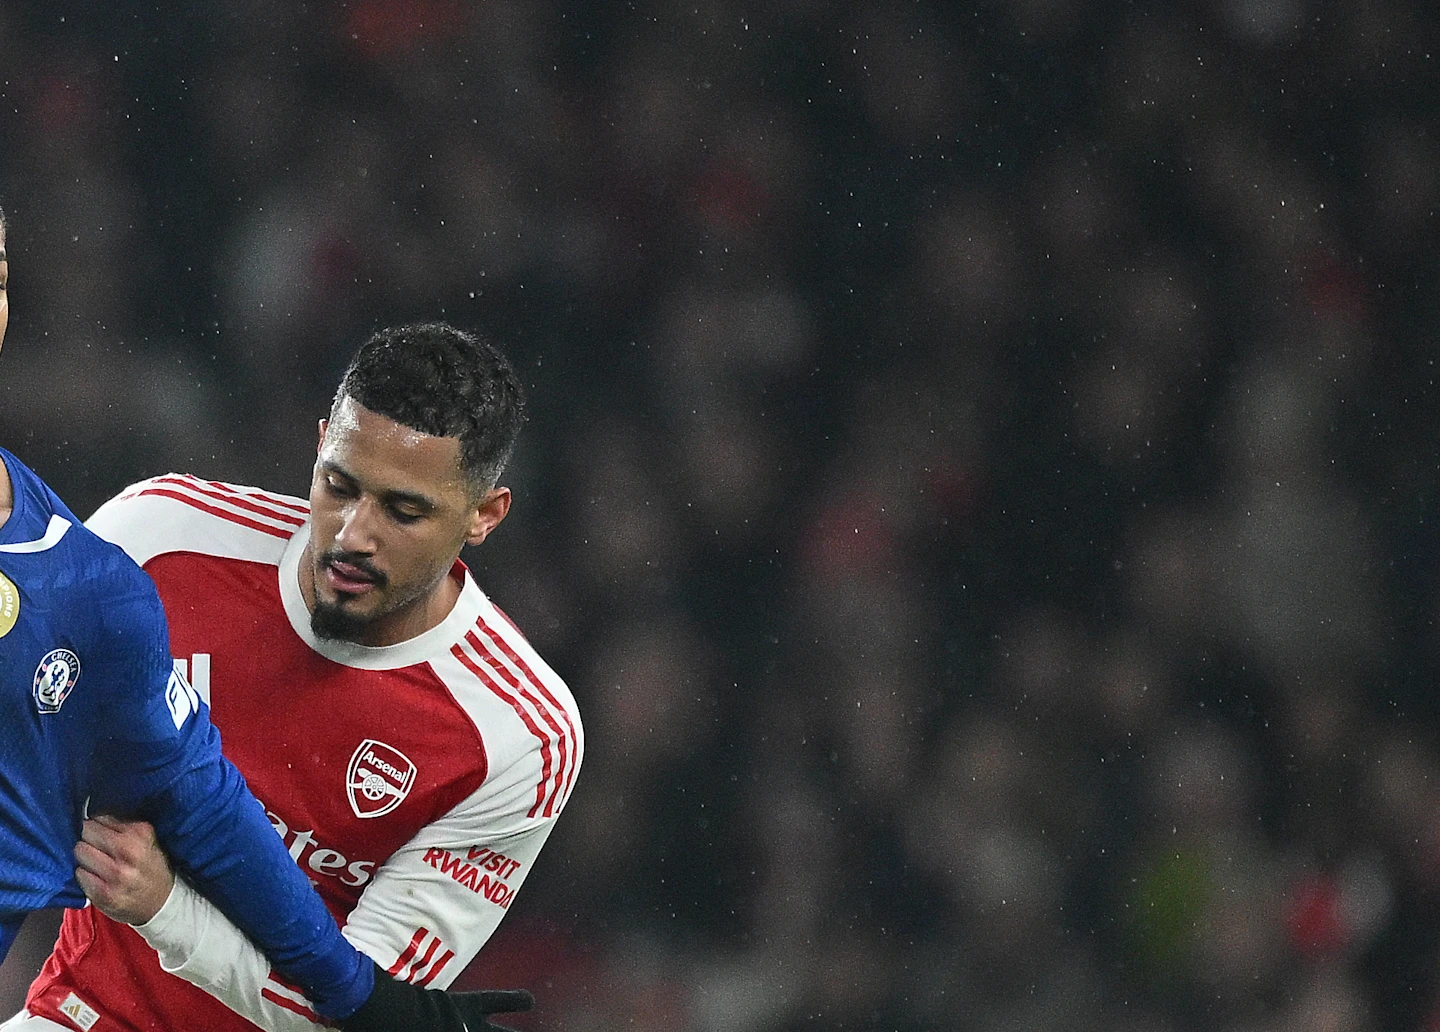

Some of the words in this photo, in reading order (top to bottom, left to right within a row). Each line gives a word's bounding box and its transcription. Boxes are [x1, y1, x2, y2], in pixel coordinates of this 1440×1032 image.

[51, 651, 77, 673] CHELSEA
[362, 751, 407, 783] Arsenal
[256, 799, 375, 886] ates
[423, 847, 515, 909] RWANDA
[467, 845, 521, 880] VISIT
